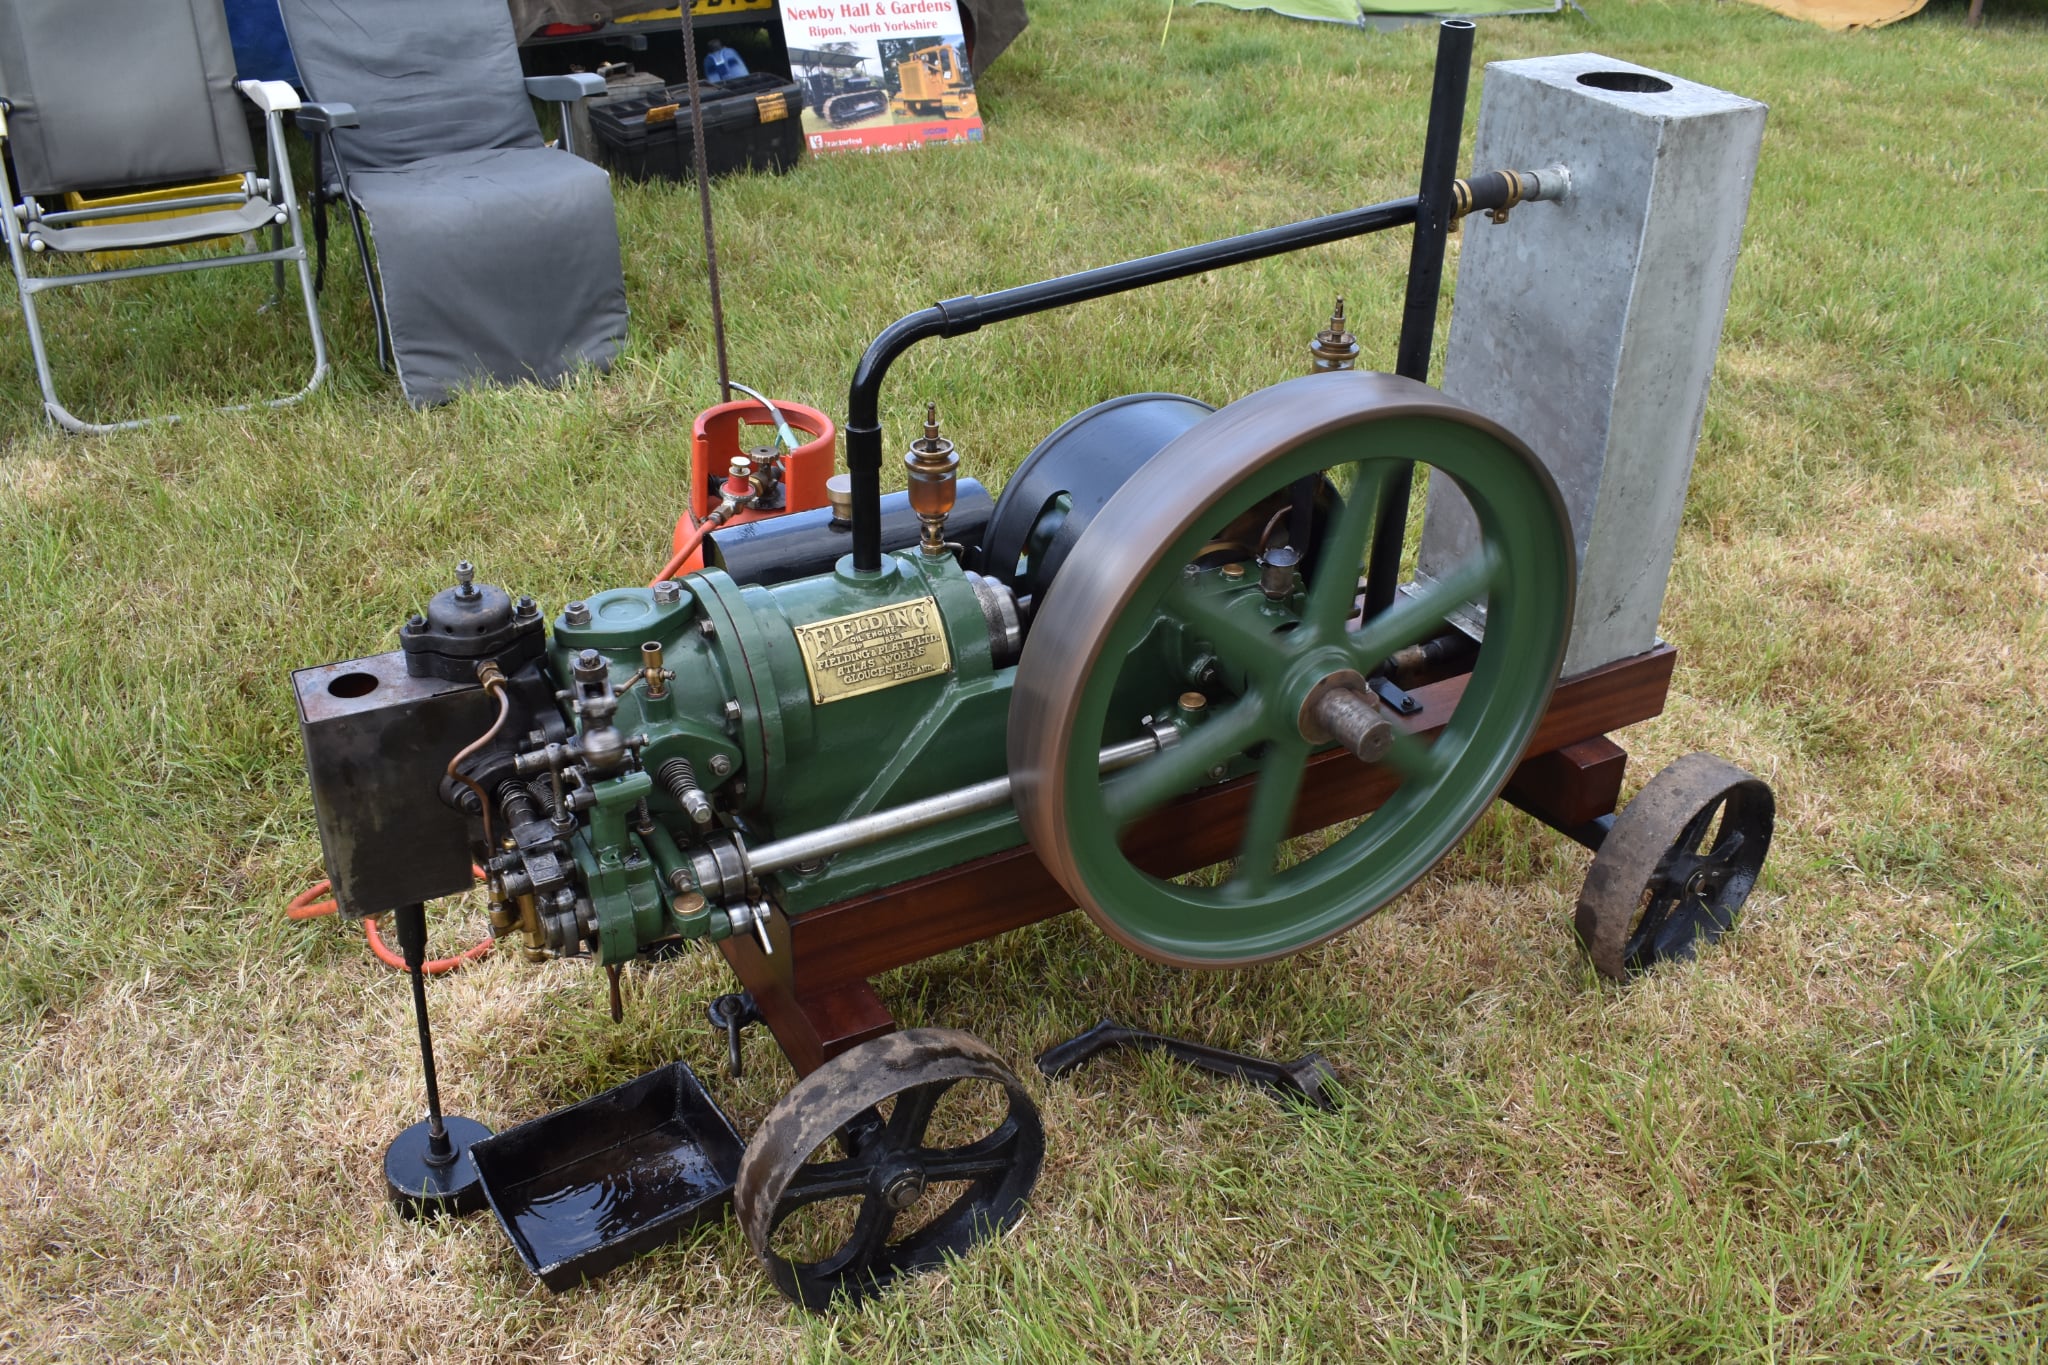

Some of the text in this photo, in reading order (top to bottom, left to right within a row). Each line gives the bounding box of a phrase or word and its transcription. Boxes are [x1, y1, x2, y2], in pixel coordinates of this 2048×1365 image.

[787, 0, 952, 21] Newby Hall & Gardens
[808, 19, 938, 38] Ripon, North Yorkshire
[809, 605, 929, 658] FIELDING
[866, 626, 896, 640] ENGINE
[816, 648, 871, 671] FIELDING
[917, 634, 941, 646] LTD.
[837, 647, 926, 676] ATLAS WORKS
[843, 661, 916, 685] GLOUCESTER
